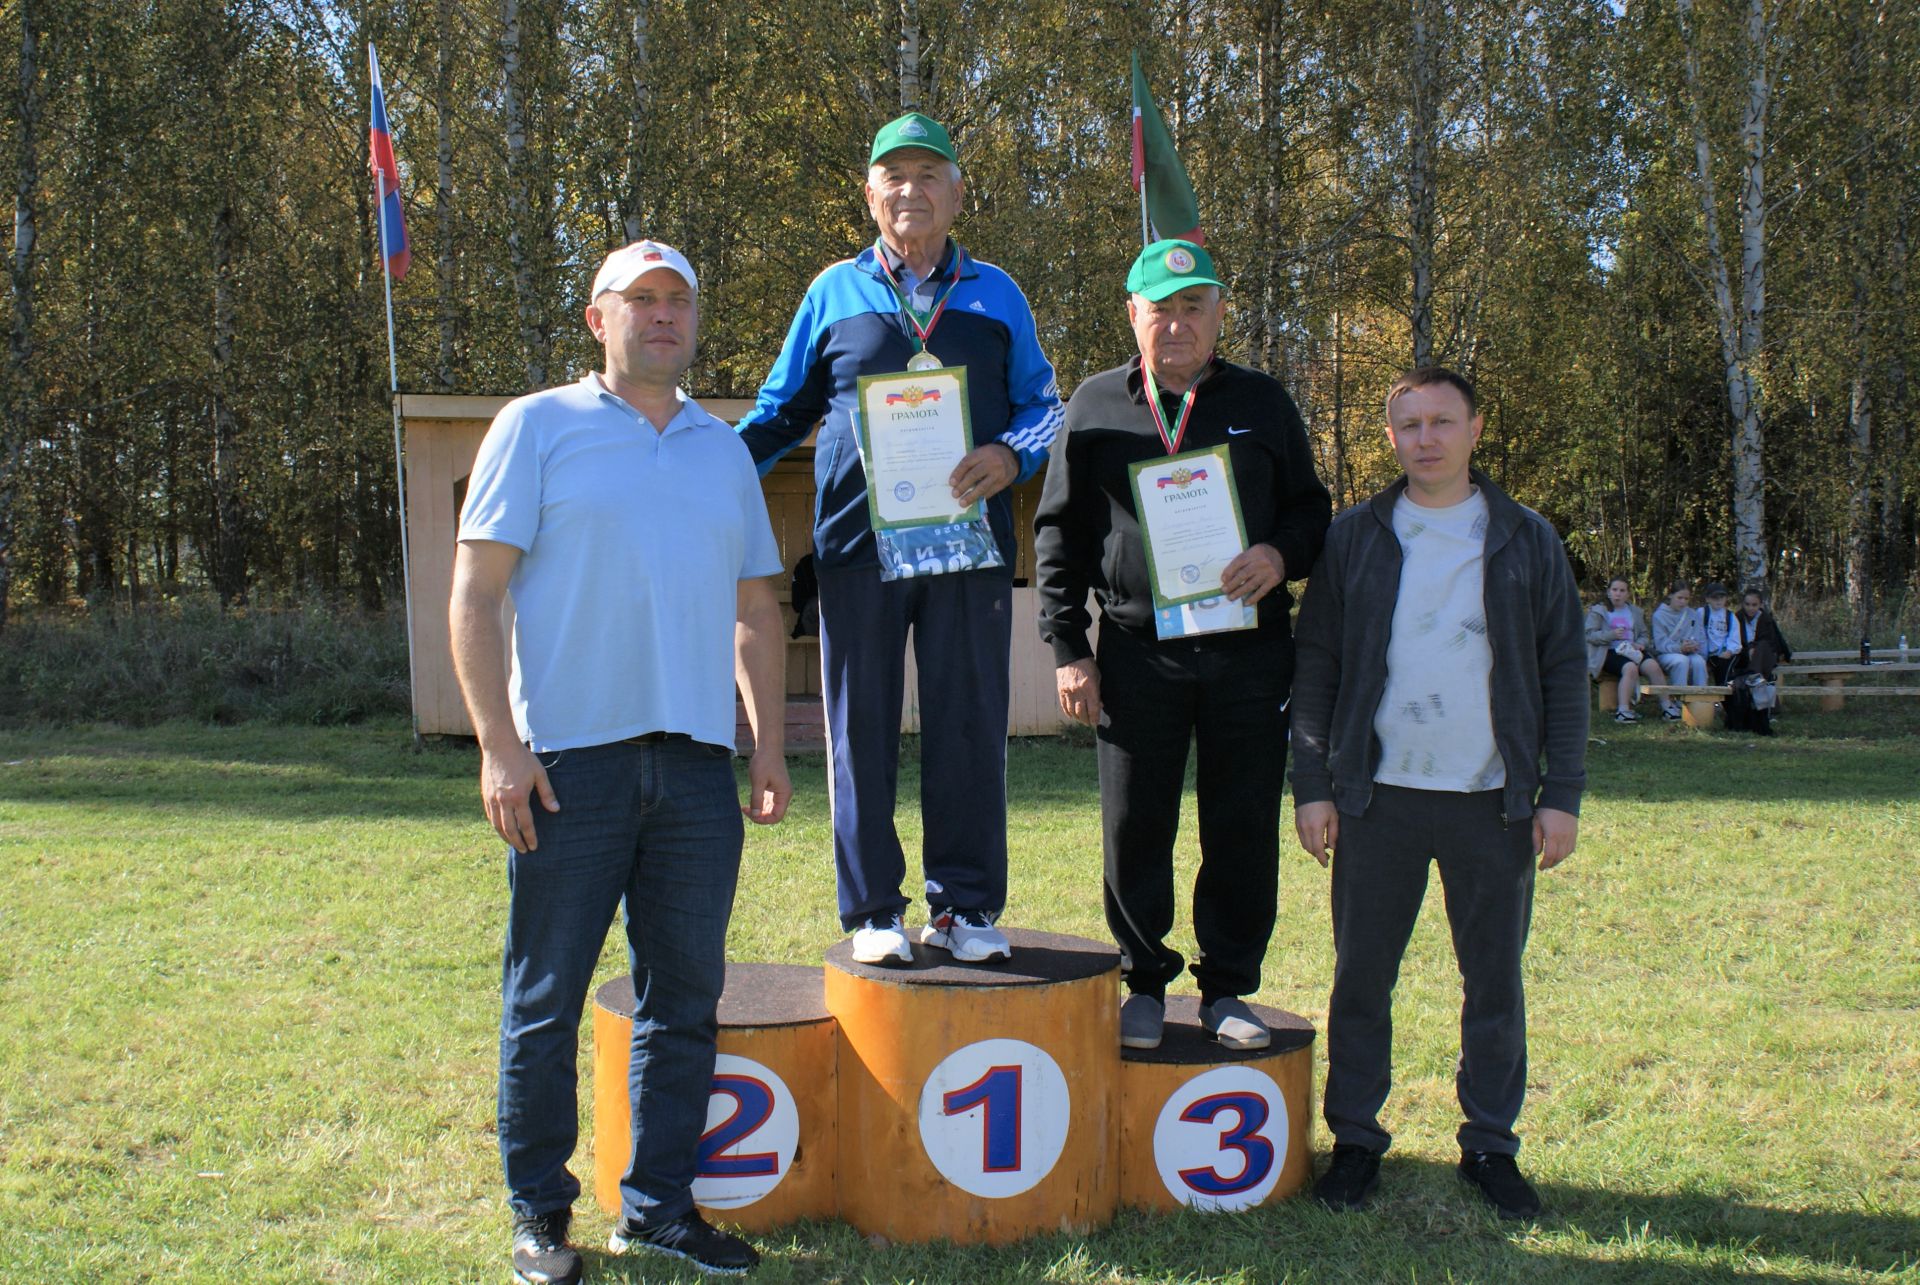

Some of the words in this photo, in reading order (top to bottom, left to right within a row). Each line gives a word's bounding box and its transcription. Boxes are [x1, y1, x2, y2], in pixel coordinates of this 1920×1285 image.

[891, 409, 939, 421] ГРАМОТА
[1164, 487, 1209, 503] ГРАМОТА
[696, 1073, 779, 1179] 2
[943, 1065, 1022, 1173] 1
[1178, 1091, 1275, 1196] 3
